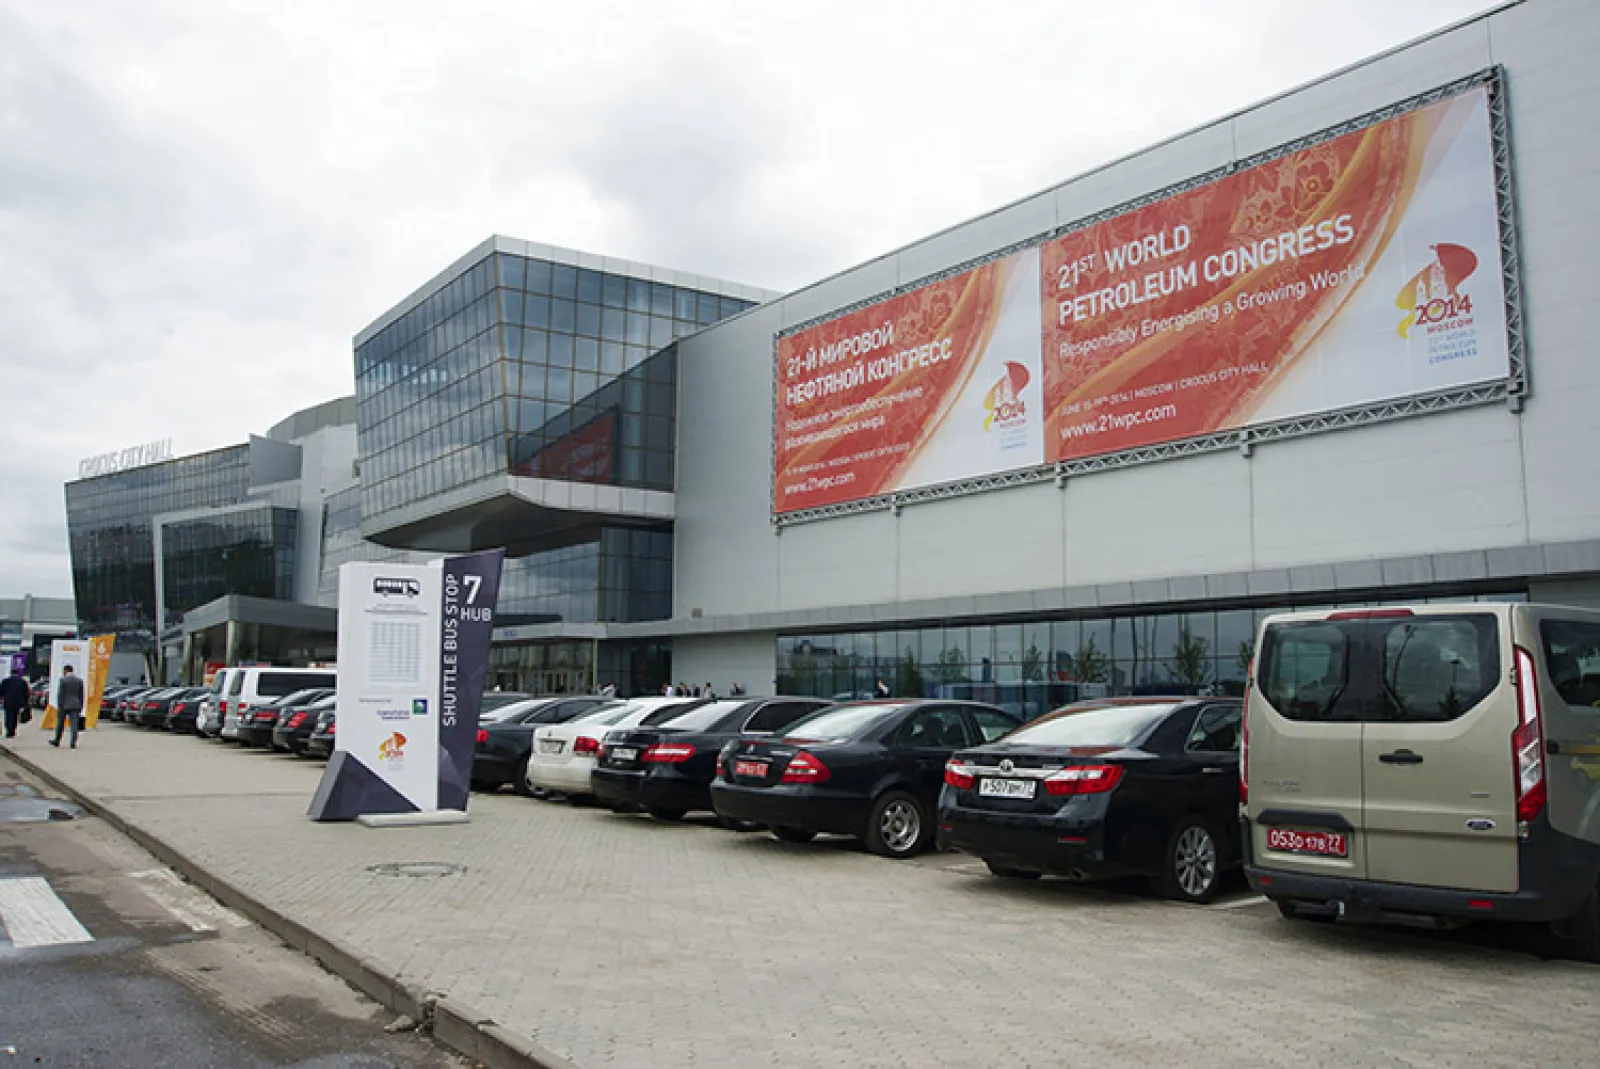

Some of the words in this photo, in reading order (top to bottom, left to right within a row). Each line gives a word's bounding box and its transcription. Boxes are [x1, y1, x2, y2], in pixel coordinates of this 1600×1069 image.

[1059, 259, 1198, 325] PETROLEUM
[1204, 214, 1354, 282] CONGRESS
[1105, 224, 1190, 273] WORLD
[1223, 300, 1233, 315] a
[1236, 281, 1307, 311] Growing
[1310, 261, 1366, 291] World
[1415, 293, 1473, 326] 2014
[819, 320, 895, 368] МИРОВОЙ
[786, 360, 865, 406] НЕФТЯНОЙ
[867, 336, 952, 383] КОНГРЕСС
[1060, 404, 1177, 440] www.21wpc.com
[445, 573, 460, 616] STOP
[462, 575, 483, 605] 7
[443, 618, 459, 651] BUS
[460, 607, 492, 622] HUB
[442, 654, 458, 727] SHUTTLE
